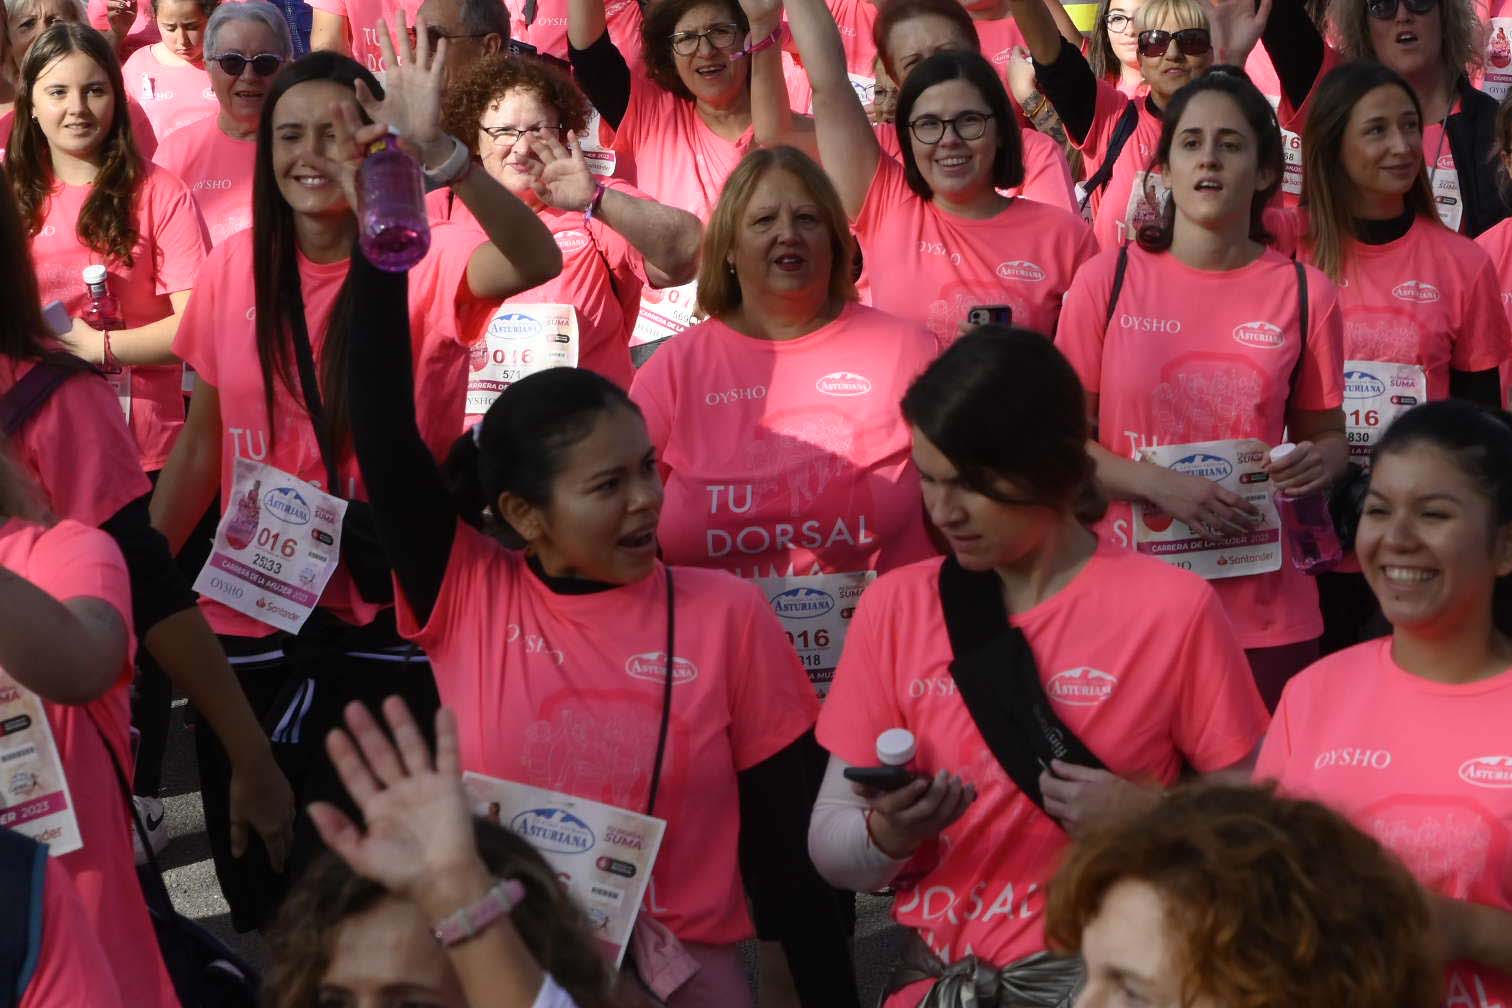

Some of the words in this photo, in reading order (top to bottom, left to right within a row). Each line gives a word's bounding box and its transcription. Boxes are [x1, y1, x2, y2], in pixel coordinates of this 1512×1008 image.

[1120, 313, 1181, 334] OYSHO
[1236, 331, 1285, 346] ASTURIANA
[821, 380, 868, 391] ASTURIANA
[1390, 380, 1416, 388] SUMA
[705, 385, 767, 406] OYSHO
[229, 428, 267, 461] TU
[706, 485, 753, 514] TU
[257, 527, 298, 558] 016
[706, 515, 873, 557] DORSAL
[1152, 543, 1189, 553] CARRERA
[1229, 551, 1274, 566] Santander
[775, 600, 830, 613] ASTURIANA
[1314, 747, 1392, 771] OYSHO
[20, 801, 51, 818] 2023
[519, 817, 588, 850] ASTURIANA
[605, 830, 643, 850] SUMA
